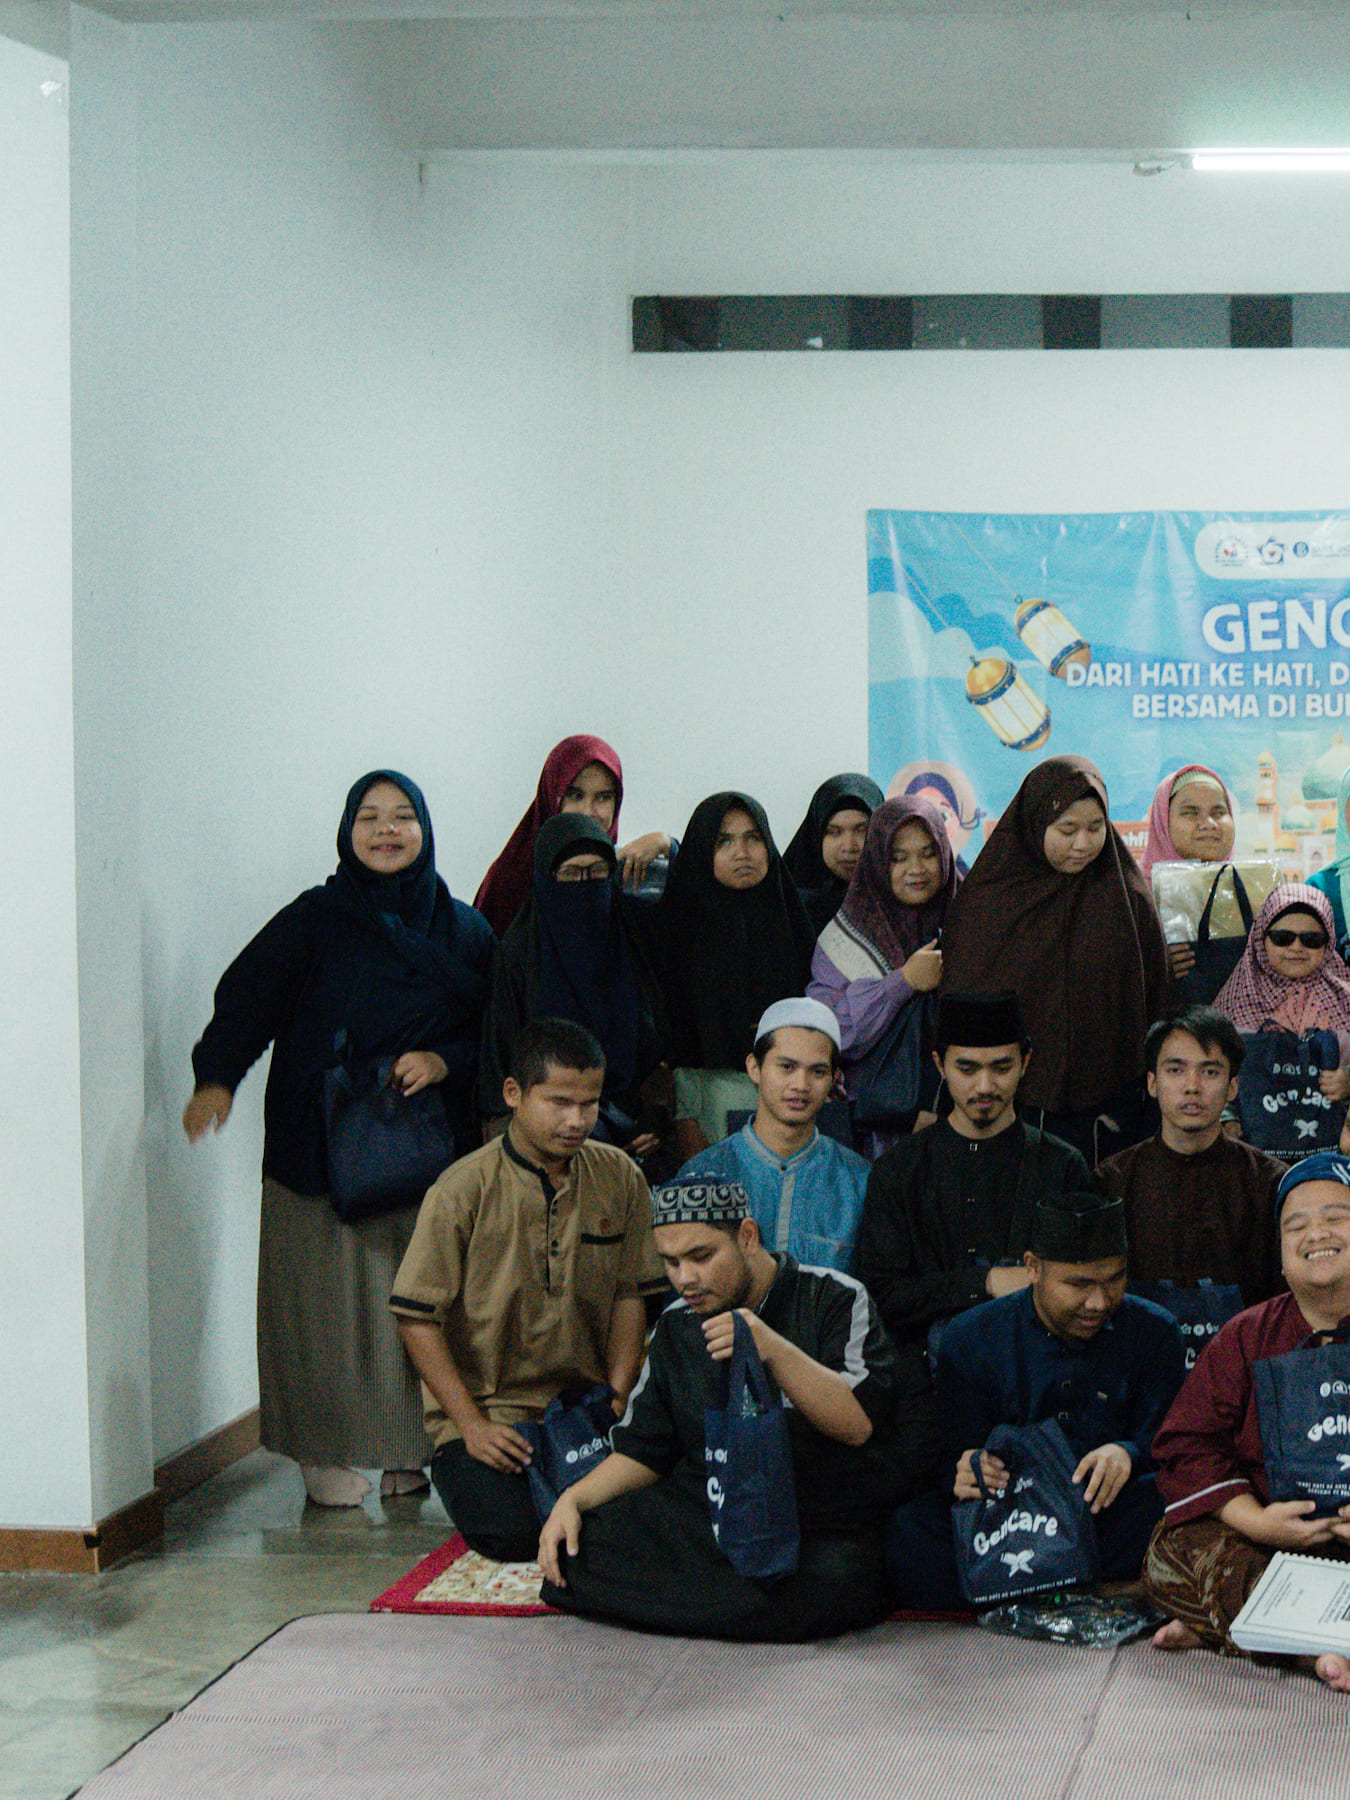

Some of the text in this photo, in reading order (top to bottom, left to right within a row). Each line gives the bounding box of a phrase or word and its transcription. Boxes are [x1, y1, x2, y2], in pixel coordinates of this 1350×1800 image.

[1066, 662, 1131, 687] DARI
[1140, 662, 1200, 687] HATI
[1209, 662, 1245, 687] KE
[1253, 662, 1321, 689] HATI,
[1132, 693, 1260, 718] BERSAMA
[1268, 693, 1296, 718] DI
[973, 1508, 1058, 1556] GenCare
